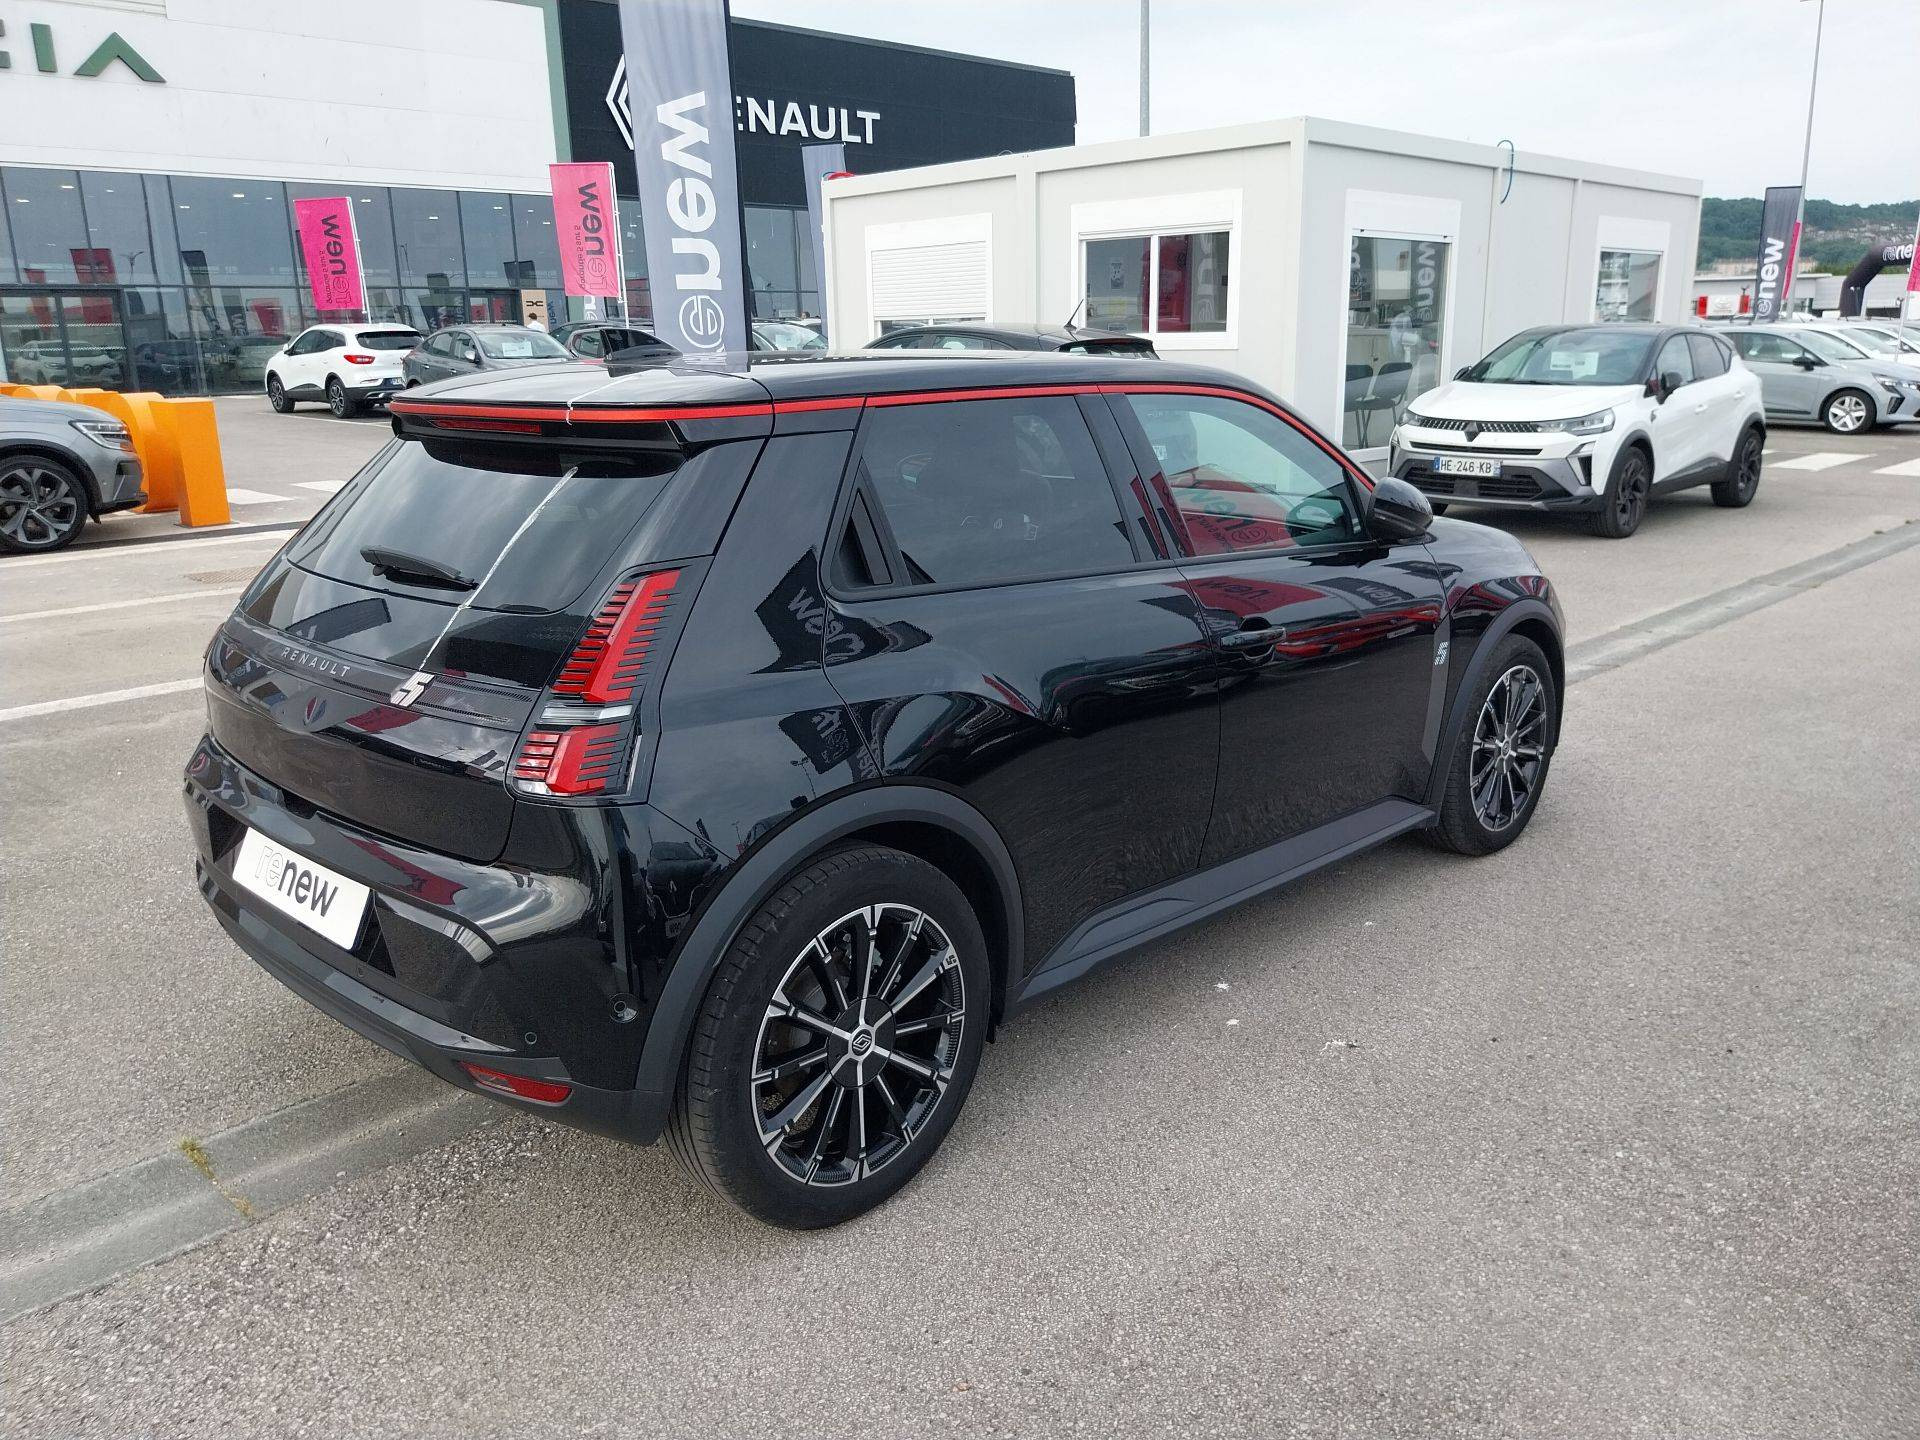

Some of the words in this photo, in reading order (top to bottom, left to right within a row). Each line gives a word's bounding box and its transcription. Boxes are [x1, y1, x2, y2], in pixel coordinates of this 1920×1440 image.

[736, 96, 881, 144] NAULT
[1758, 237, 1784, 317] enew
[1882, 244, 1913, 262] rene
[281, 647, 350, 677] RENAULT
[254, 845, 339, 918] renew
